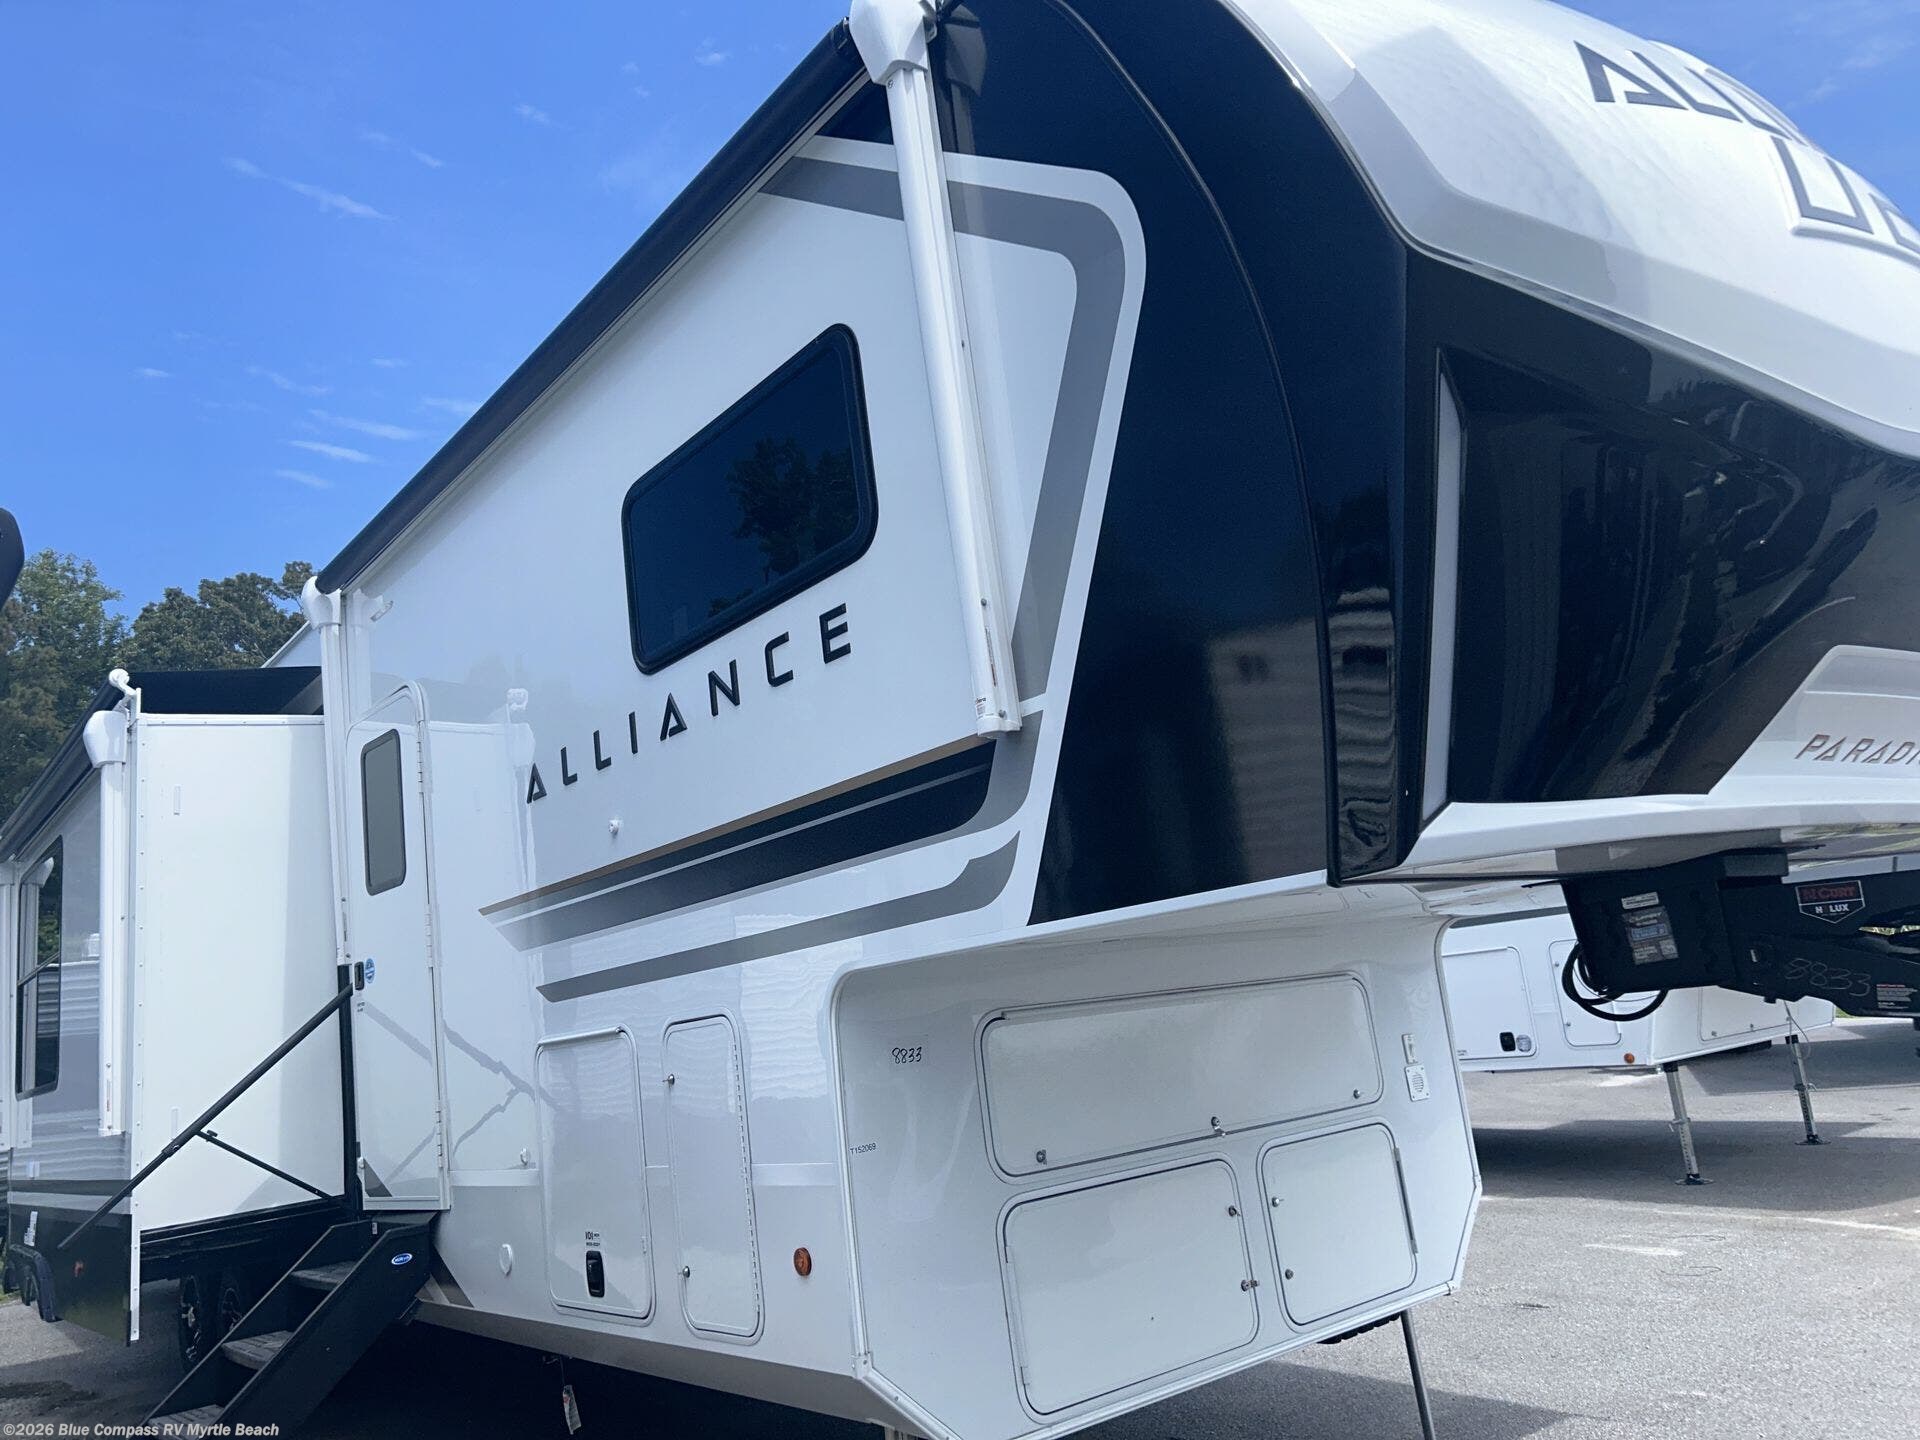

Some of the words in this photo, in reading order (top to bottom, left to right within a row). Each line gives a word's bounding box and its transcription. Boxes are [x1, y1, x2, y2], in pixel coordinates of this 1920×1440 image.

[527, 602, 851, 804] ALLIANCE
[1794, 734, 1920, 765] PARADI
[1784, 958, 1871, 996] 8833
[891, 1046, 923, 1064] 8833
